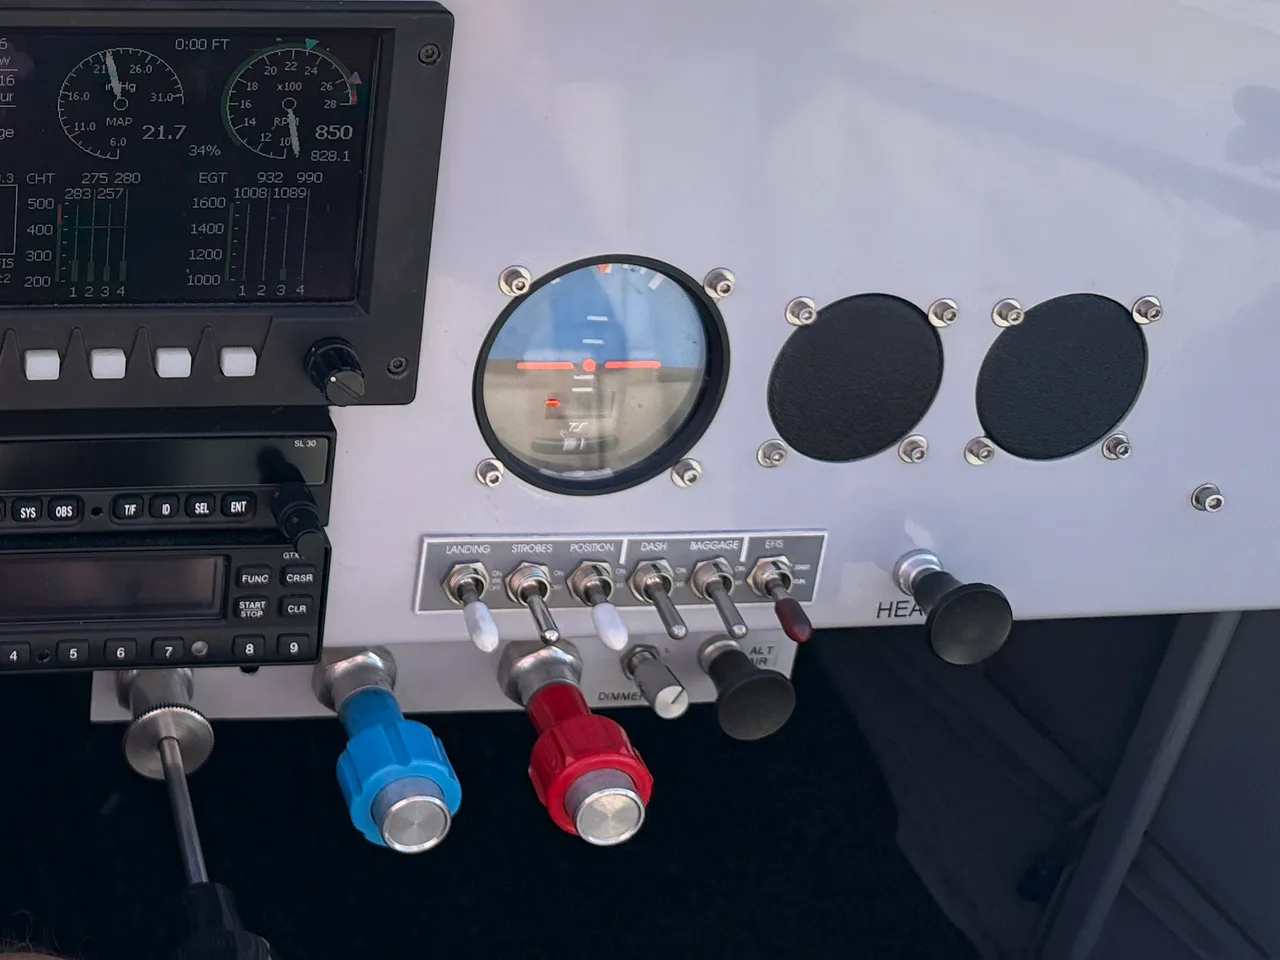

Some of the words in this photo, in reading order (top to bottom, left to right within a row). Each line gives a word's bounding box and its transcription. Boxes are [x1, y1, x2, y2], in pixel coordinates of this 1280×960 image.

[175, 38, 207, 50] 0:00
[211, 38, 230, 50] FT
[129, 64, 153, 74] 26.0
[105, 117, 133, 126] MAP
[142, 125, 187, 140] 21.7
[315, 125, 353, 140] 850
[188, 145, 221, 156] 34%
[311, 150, 351, 161] 828.1
[26, 173, 56, 184] CHT
[81, 172, 108, 184] 275
[114, 172, 141, 183] 280
[198, 172, 228, 183] EGT
[257, 172, 284, 183] 932
[296, 172, 323, 183] 990
[65, 188, 91, 199] 283
[97, 188, 124, 199] 257
[234, 187, 267, 199] 1008
[273, 187, 307, 198] 1089
[28, 198, 54, 209] 500
[192, 197, 226, 209] 1600
[27, 224, 53, 235] 400
[190, 223, 224, 234] 1400
[25, 250, 52, 261] 300
[189, 249, 222, 260] 1200
[24, 276, 51, 287] 200
[187, 275, 220, 286] 1000
[55, 505, 73, 518] OBS
[124, 503, 136, 516] T/F
[161, 502, 171, 515] ID
[194, 501, 210, 514] SEL
[230, 500, 246, 513] ENT
[20, 506, 36, 519] SYS
[446, 544, 491, 554] LANDING
[511, 543, 553, 553] STROBES
[570, 543, 614, 552] POSITION
[640, 542, 667, 551] DASH
[690, 540, 739, 550] BAGGAGE
[765, 539, 783, 548] EFIS
[242, 573, 269, 584] FUNC
[286, 573, 313, 583] CRSR
[239, 600, 266, 610] START
[287, 604, 307, 614] CLR
[876, 600, 924, 618] HEA
[240, 610, 264, 619] STOP
[749, 646, 774, 655] ALT
[598, 691, 644, 701] DIMME
